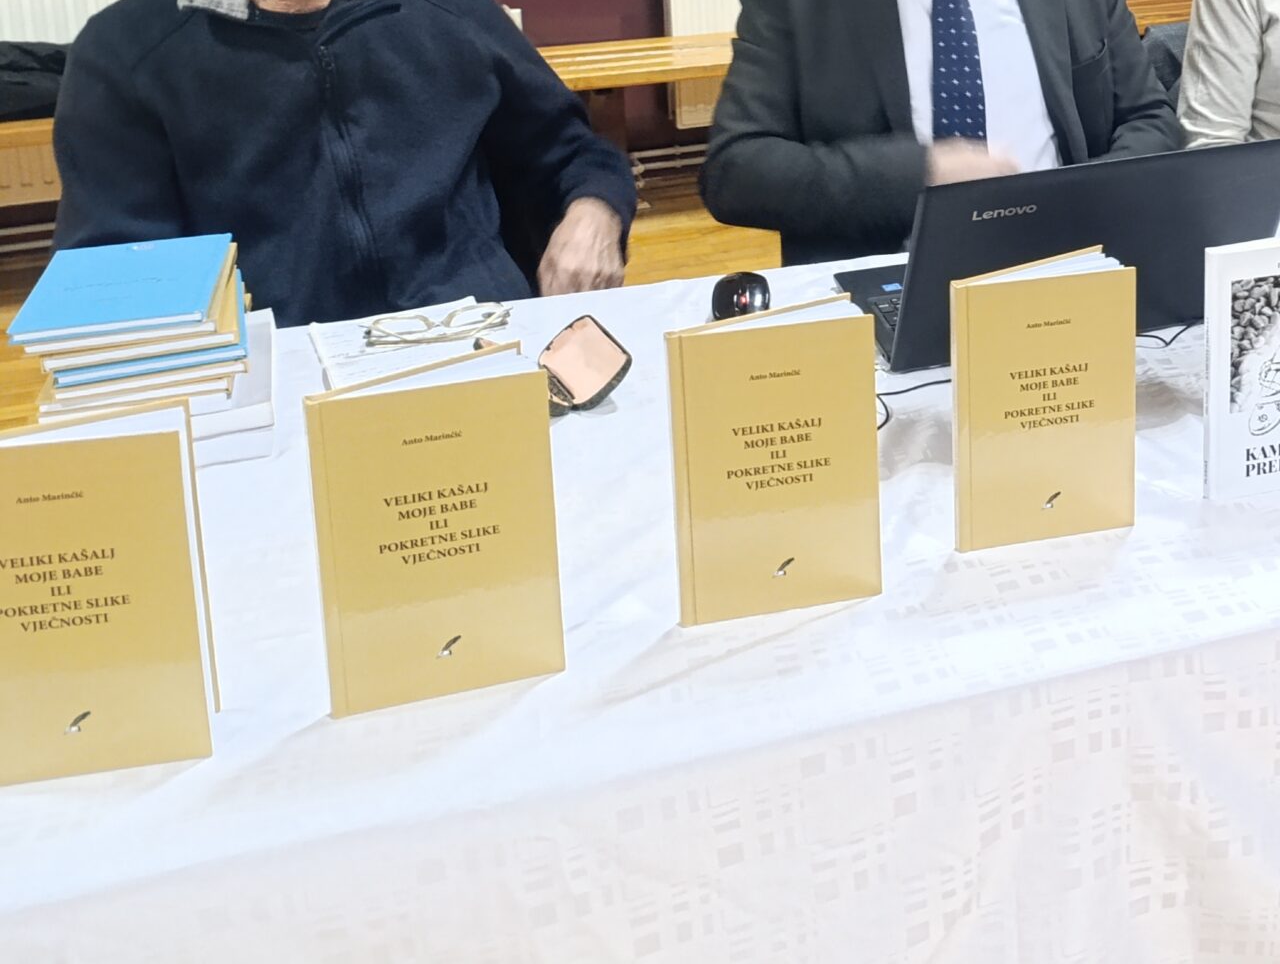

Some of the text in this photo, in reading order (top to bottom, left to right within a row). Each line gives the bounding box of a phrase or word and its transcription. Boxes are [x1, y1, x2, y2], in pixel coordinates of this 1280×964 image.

[972, 204, 1037, 221] Lenovo
[1010, 362, 1089, 380] VELIKI KAŠALJ
[1020, 376, 1079, 392] MOJE BABE
[1043, 392, 1057, 402] ILI
[1004, 399, 1095, 420] POKRETNE SLIKE
[732, 417, 822, 437] VELIKI KAŠALJ
[1020, 413, 1079, 431] VJEČNOSTI
[744, 432, 812, 449] MOJE BABE
[770, 449, 787, 460] ILI
[726, 457, 831, 480] POKRETNE SLIKE
[746, 472, 813, 491] VJEČNOSTI
[383, 482, 488, 508] VELIKI KAŠALJ
[397, 499, 477, 521] MOJE BABE
[429, 518, 448, 530] ILI
[379, 524, 500, 554] POKRETNE SLIKE
[0, 548, 115, 569] VELIKI KAŠALJ
[401, 543, 480, 565] VJEČNOSTI
[15, 565, 103, 584] MOJE BABE
[50, 585, 72, 596] ILI
[86, 594, 130, 609] SLIKE
[20, 613, 108, 632] VJEČNOSTI
